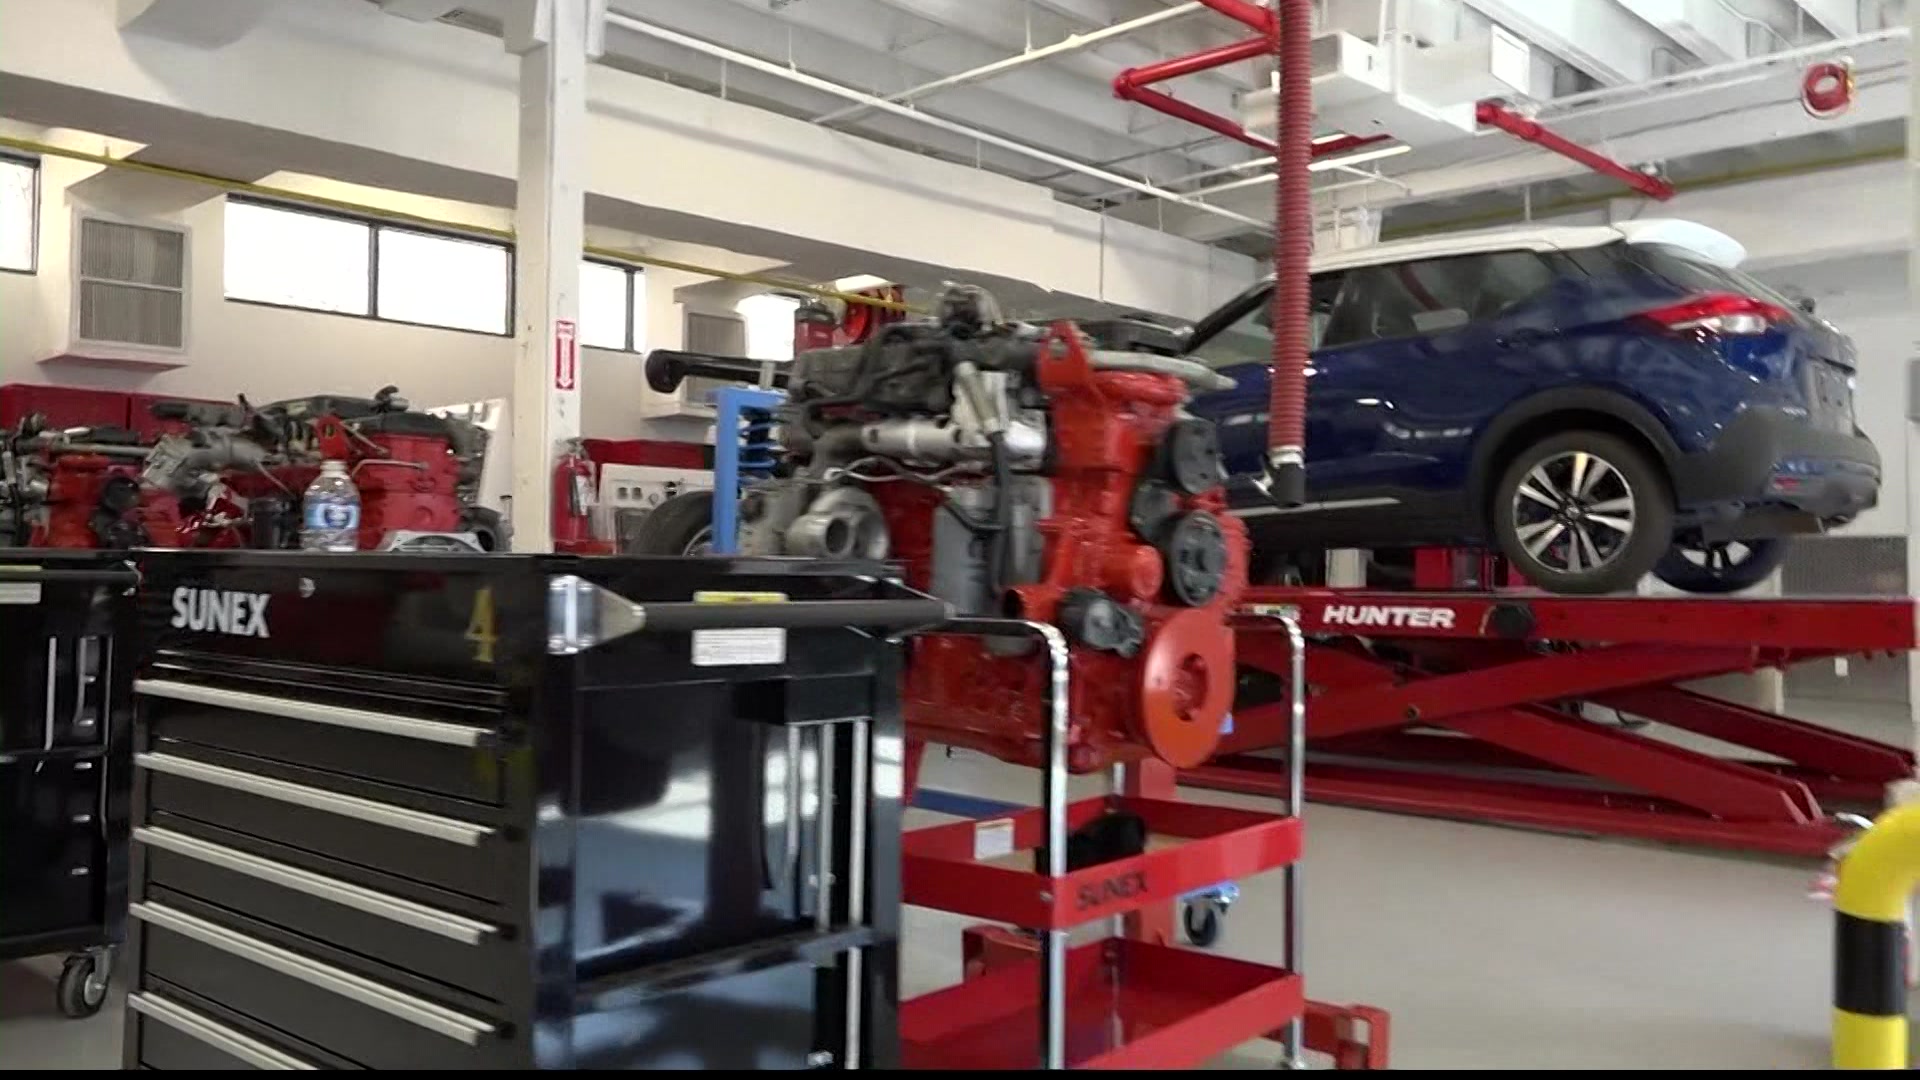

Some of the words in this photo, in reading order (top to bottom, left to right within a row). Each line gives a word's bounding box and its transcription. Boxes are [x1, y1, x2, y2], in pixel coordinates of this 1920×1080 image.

[171, 586, 271, 638] SUNEX
[464, 587, 499, 663] 4
[1323, 605, 1455, 628] HUNTER
[1075, 870, 1147, 911] SUNEX
